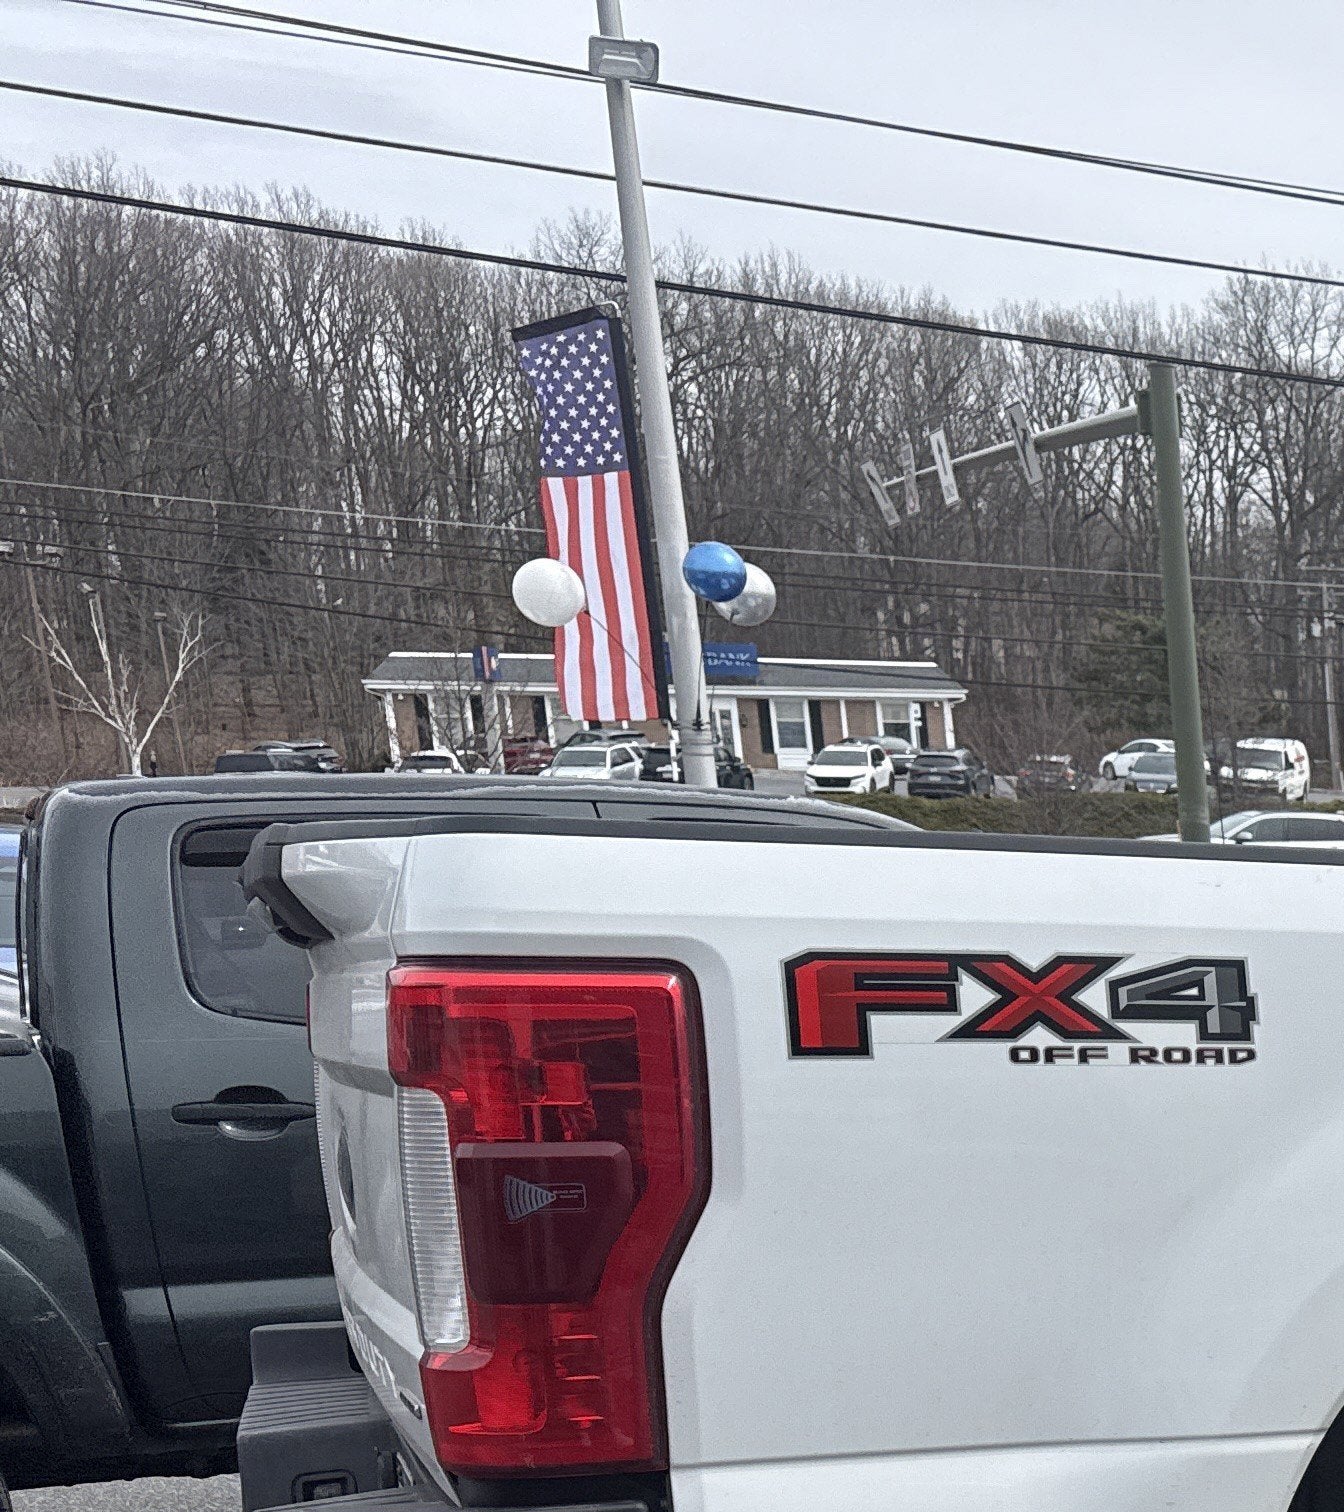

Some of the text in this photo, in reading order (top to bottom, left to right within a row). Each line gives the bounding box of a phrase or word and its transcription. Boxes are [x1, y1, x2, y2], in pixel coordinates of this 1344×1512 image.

[779, 947, 1260, 1060] FX4
[1008, 1044, 1258, 1066] OFF ROAD
